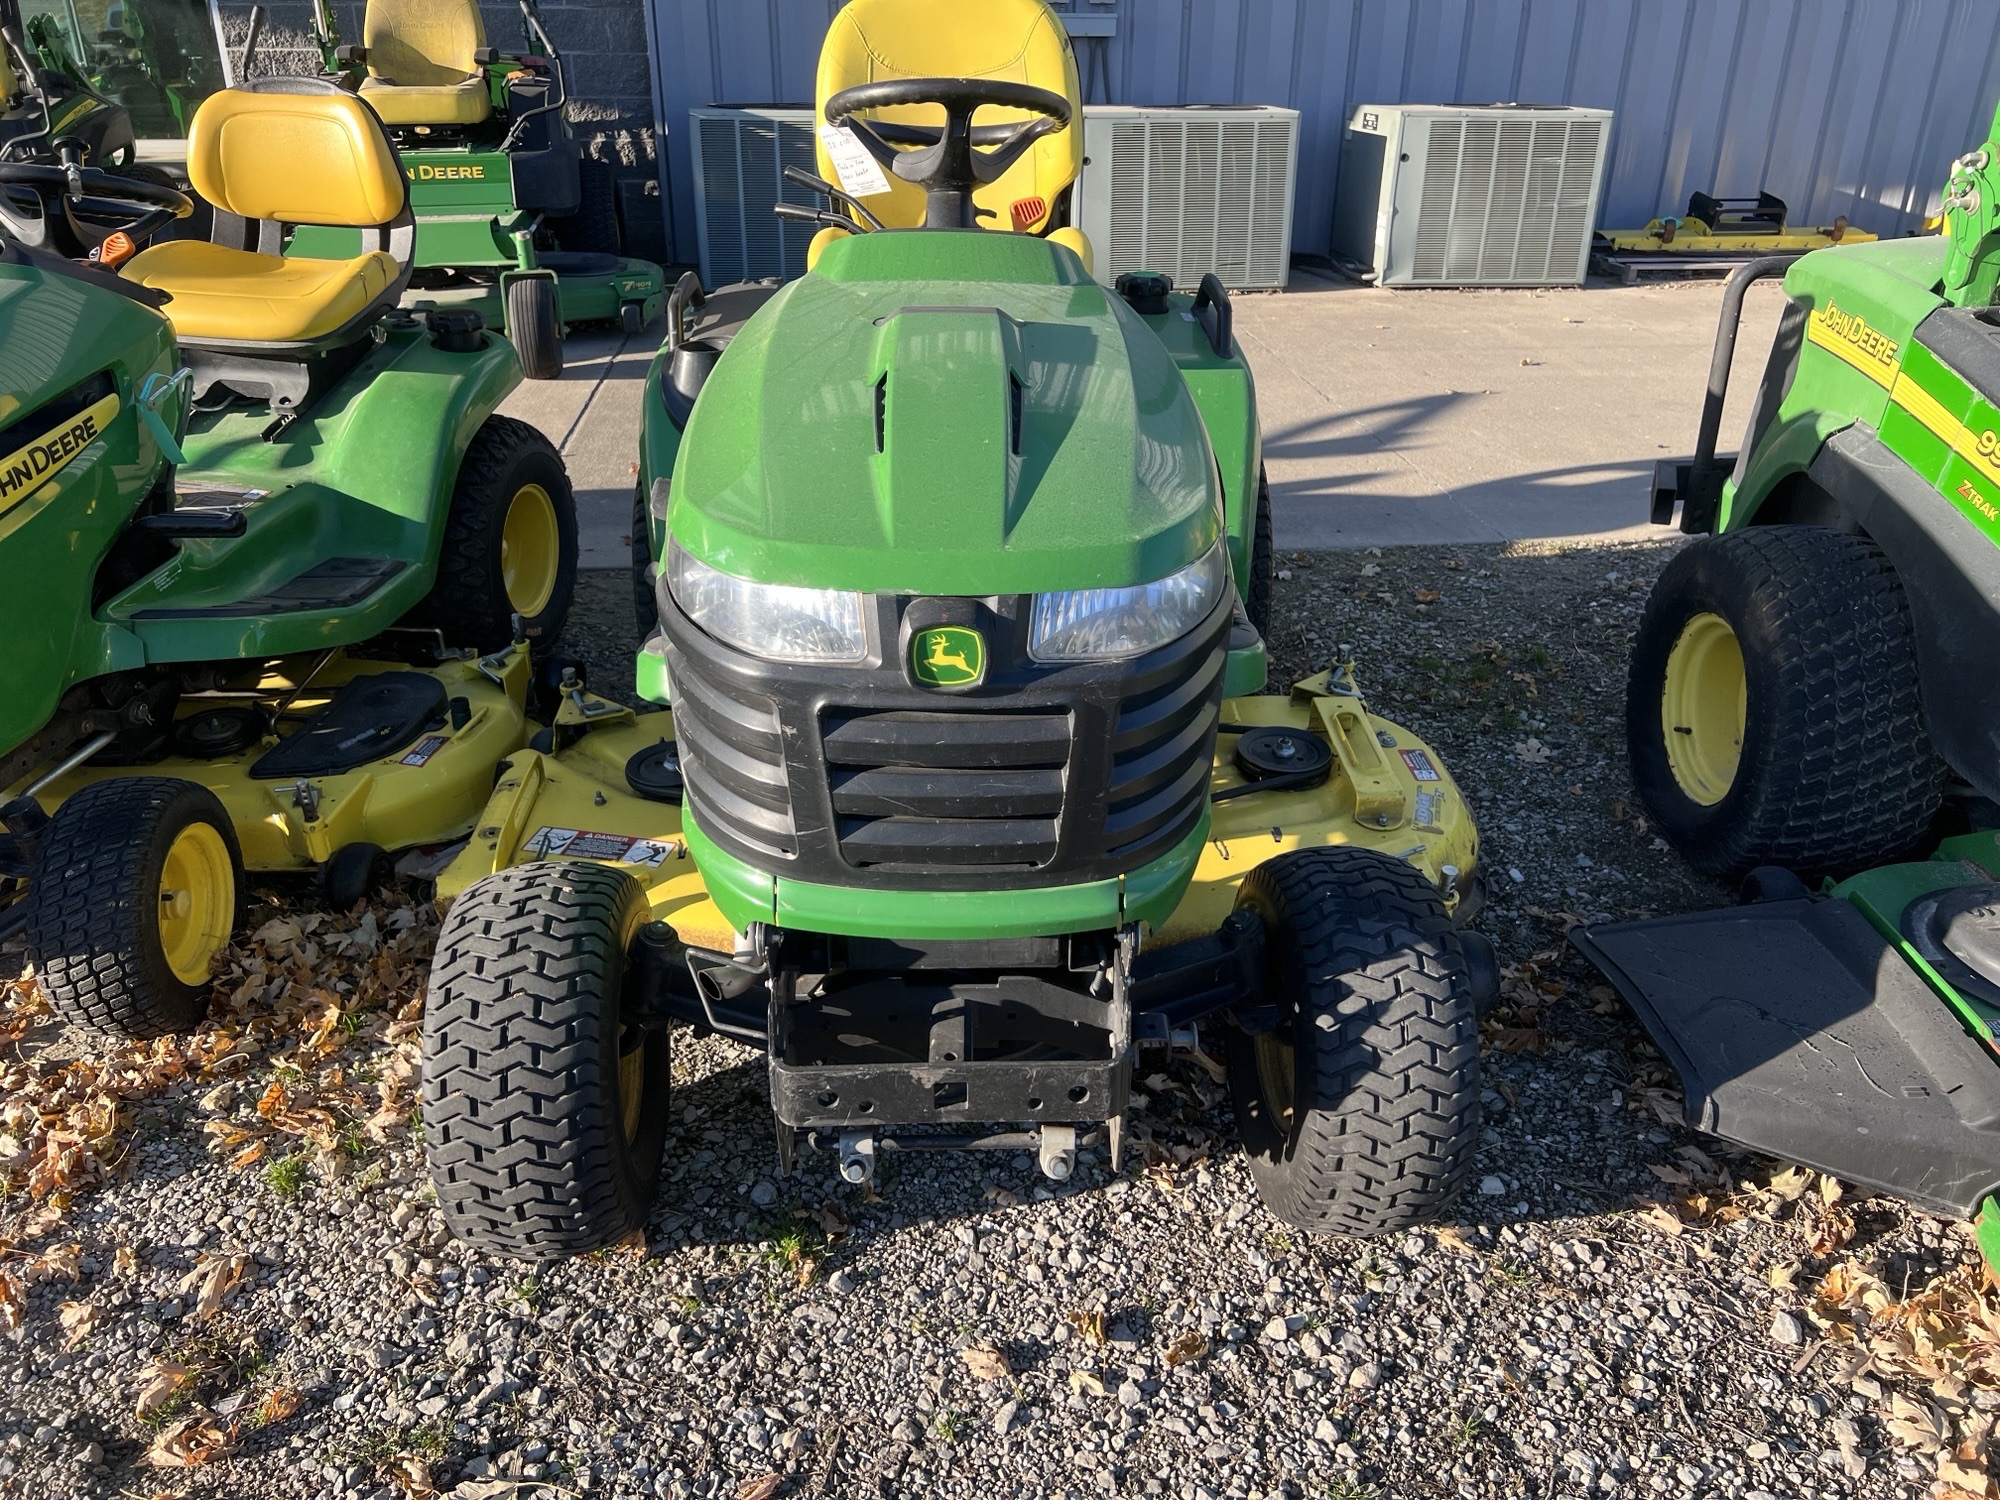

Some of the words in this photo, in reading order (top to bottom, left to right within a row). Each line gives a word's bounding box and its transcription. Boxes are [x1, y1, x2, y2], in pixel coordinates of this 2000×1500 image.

[418, 164, 485, 180] DEERE
[1818, 297, 1856, 341] JOHN
[1846, 314, 1900, 367] DEERE
[26, 415, 98, 476] DEERE
[593, 833, 630, 843] DANGER
